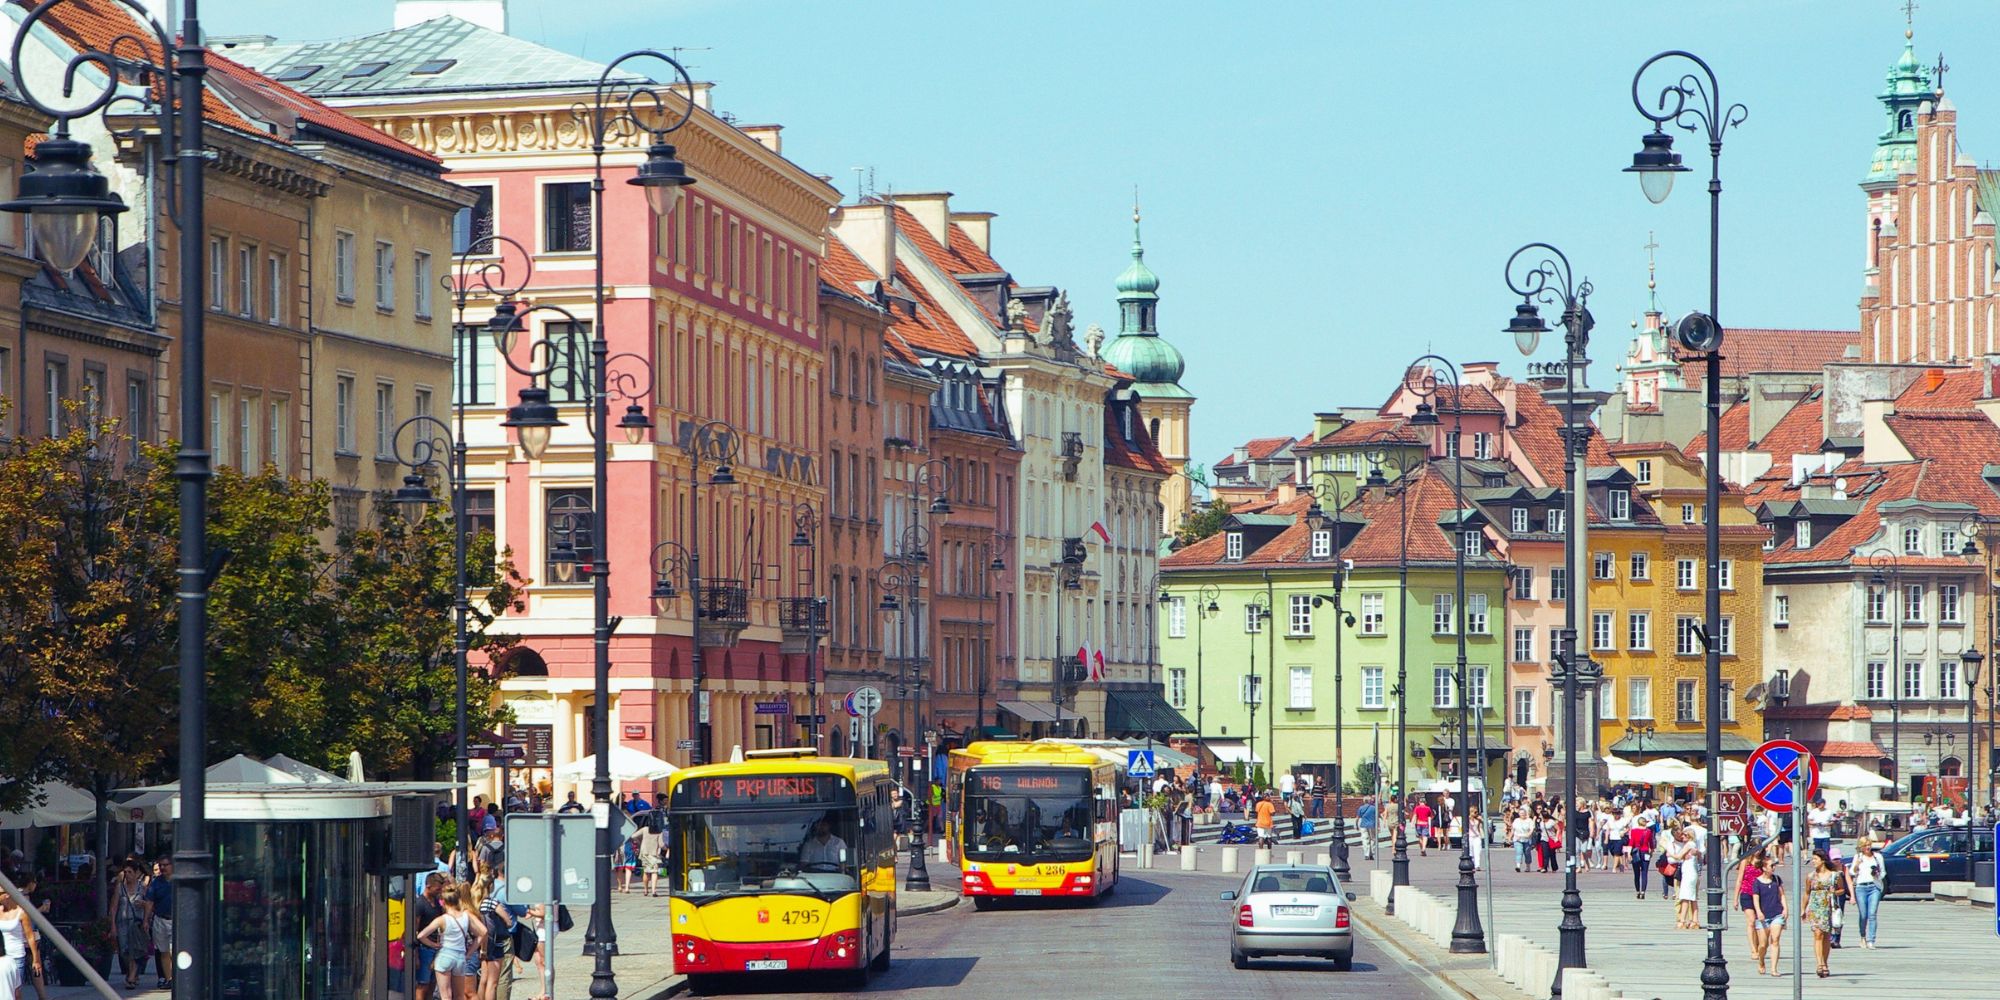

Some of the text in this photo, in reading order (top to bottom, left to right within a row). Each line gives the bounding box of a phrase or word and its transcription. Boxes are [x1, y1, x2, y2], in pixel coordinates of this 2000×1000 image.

[699, 777, 815, 799] 178 PKP URSUS
[981, 776, 1001, 790] 116
[1720, 819, 1734, 831] WC
[1035, 865, 1066, 876] A 236
[782, 909, 820, 925] 4795
